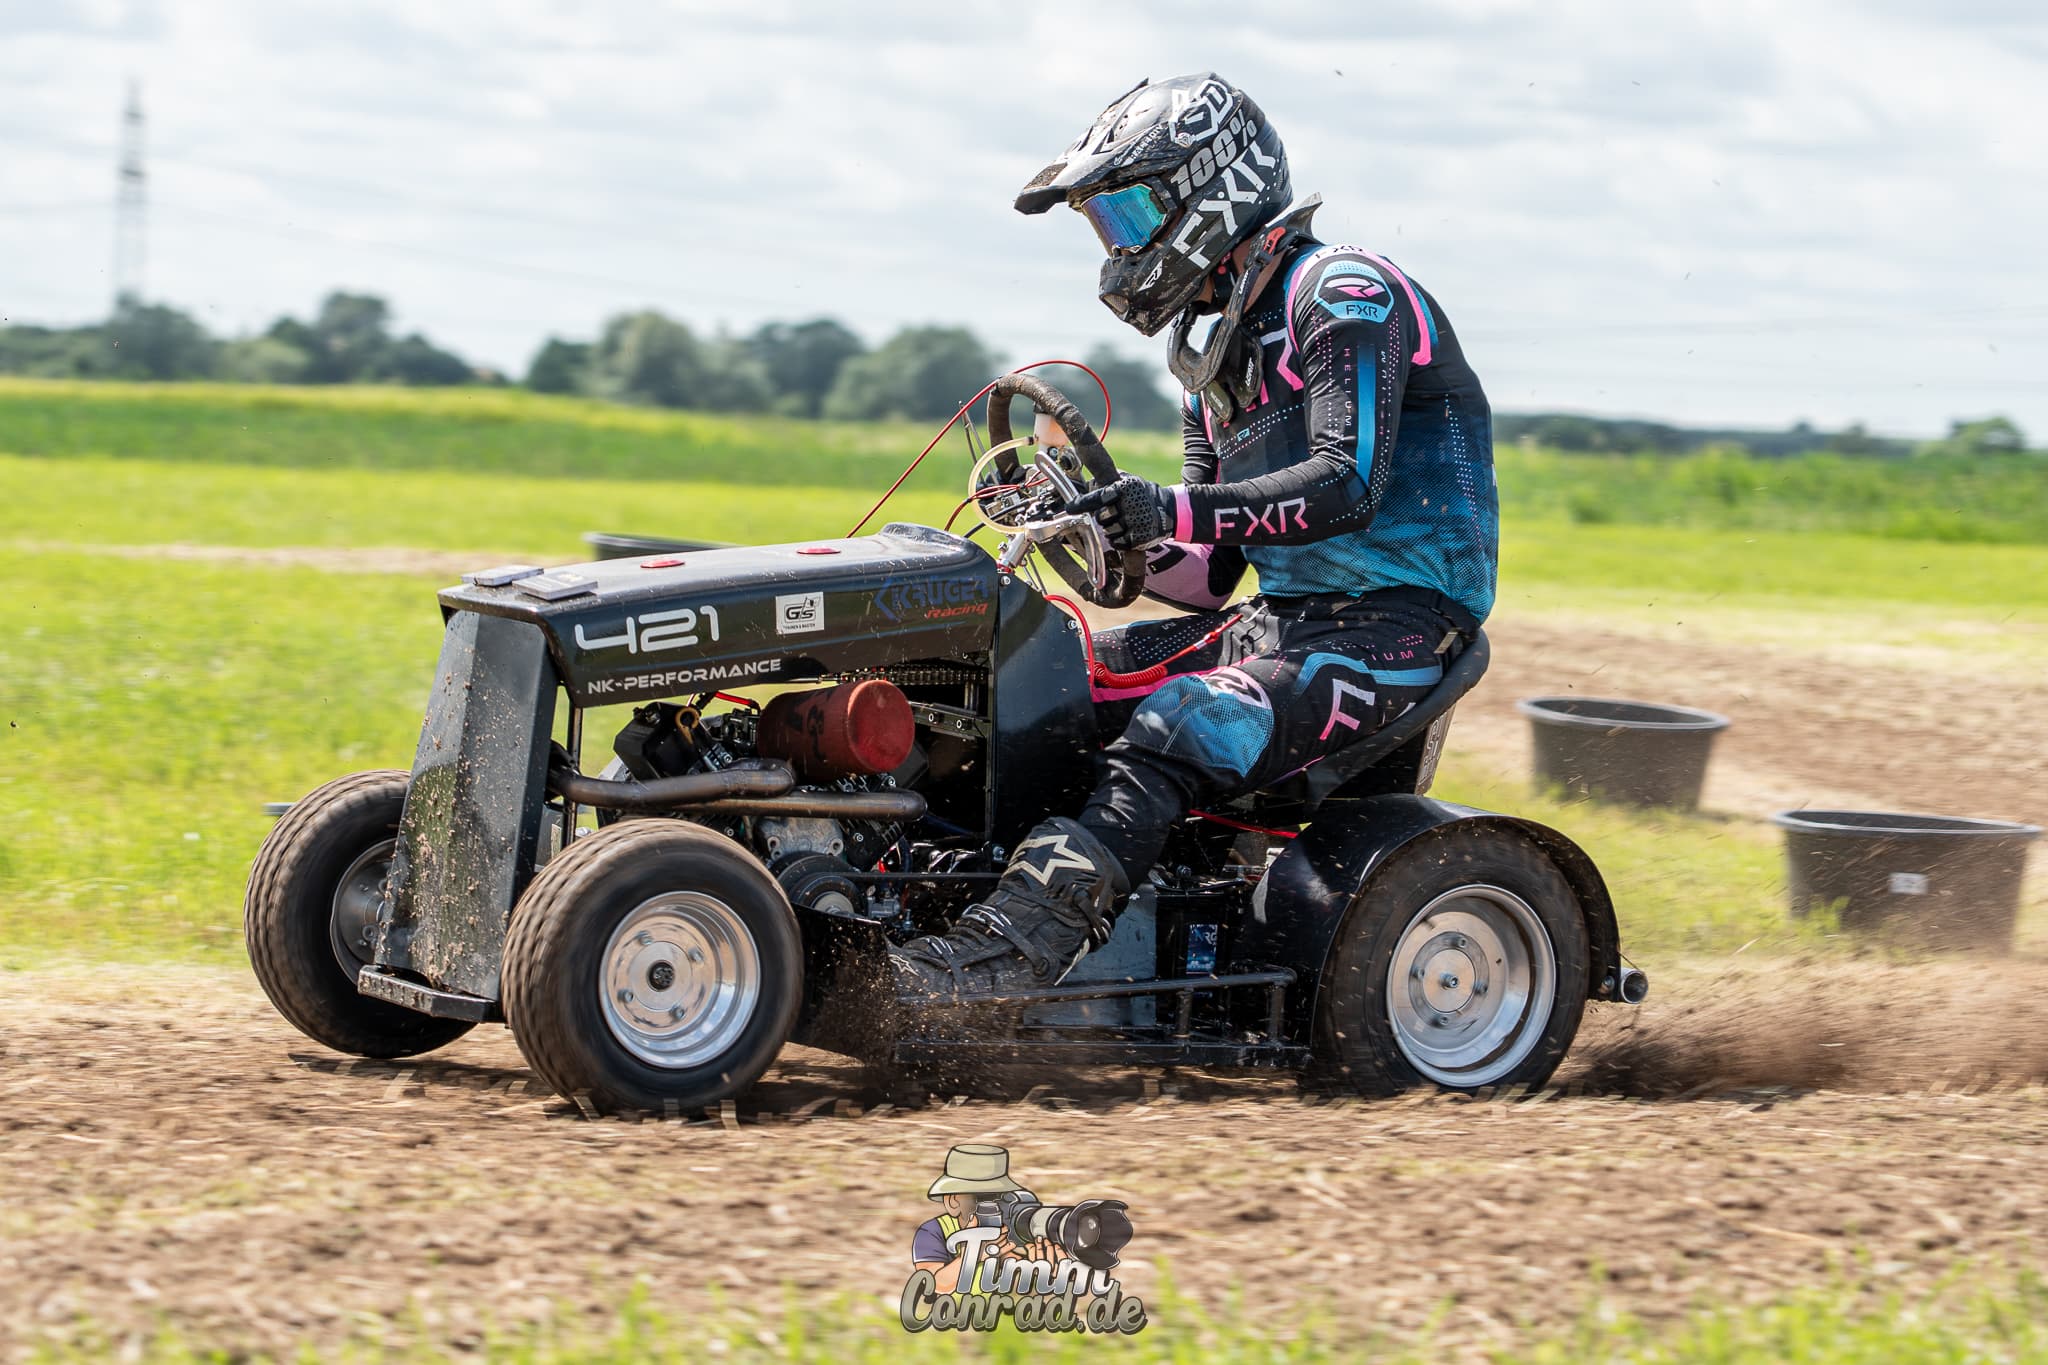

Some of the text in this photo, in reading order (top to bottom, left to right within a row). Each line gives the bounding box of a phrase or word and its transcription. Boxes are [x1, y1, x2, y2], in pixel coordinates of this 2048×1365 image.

[1171, 108, 1258, 200] 100%
[1172, 140, 1276, 269] FXR
[1346, 303, 1379, 318] FXR
[1343, 348, 1353, 426] HELIUM
[1213, 496, 1310, 540] FXR
[574, 604, 720, 654] 421
[588, 658, 782, 695] NK-PERFORMANCE
